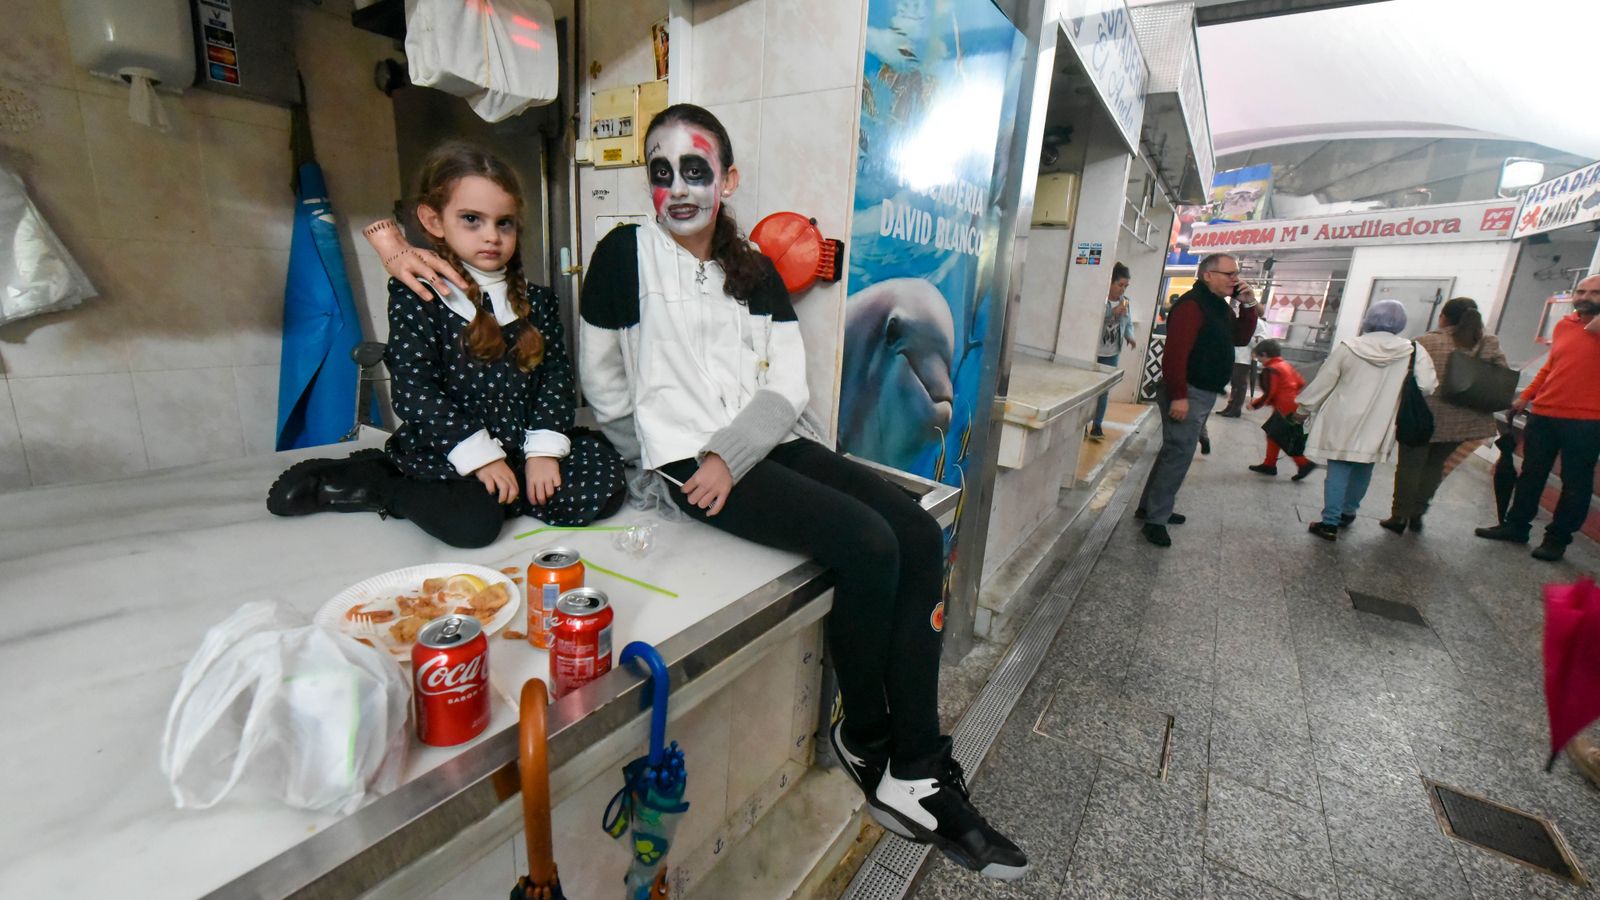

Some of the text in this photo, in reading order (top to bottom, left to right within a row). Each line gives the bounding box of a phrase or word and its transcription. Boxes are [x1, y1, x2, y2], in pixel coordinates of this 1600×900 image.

[880, 198, 984, 257] DAVID BLANCO
[1313, 216, 1462, 241] Auxiliadora
